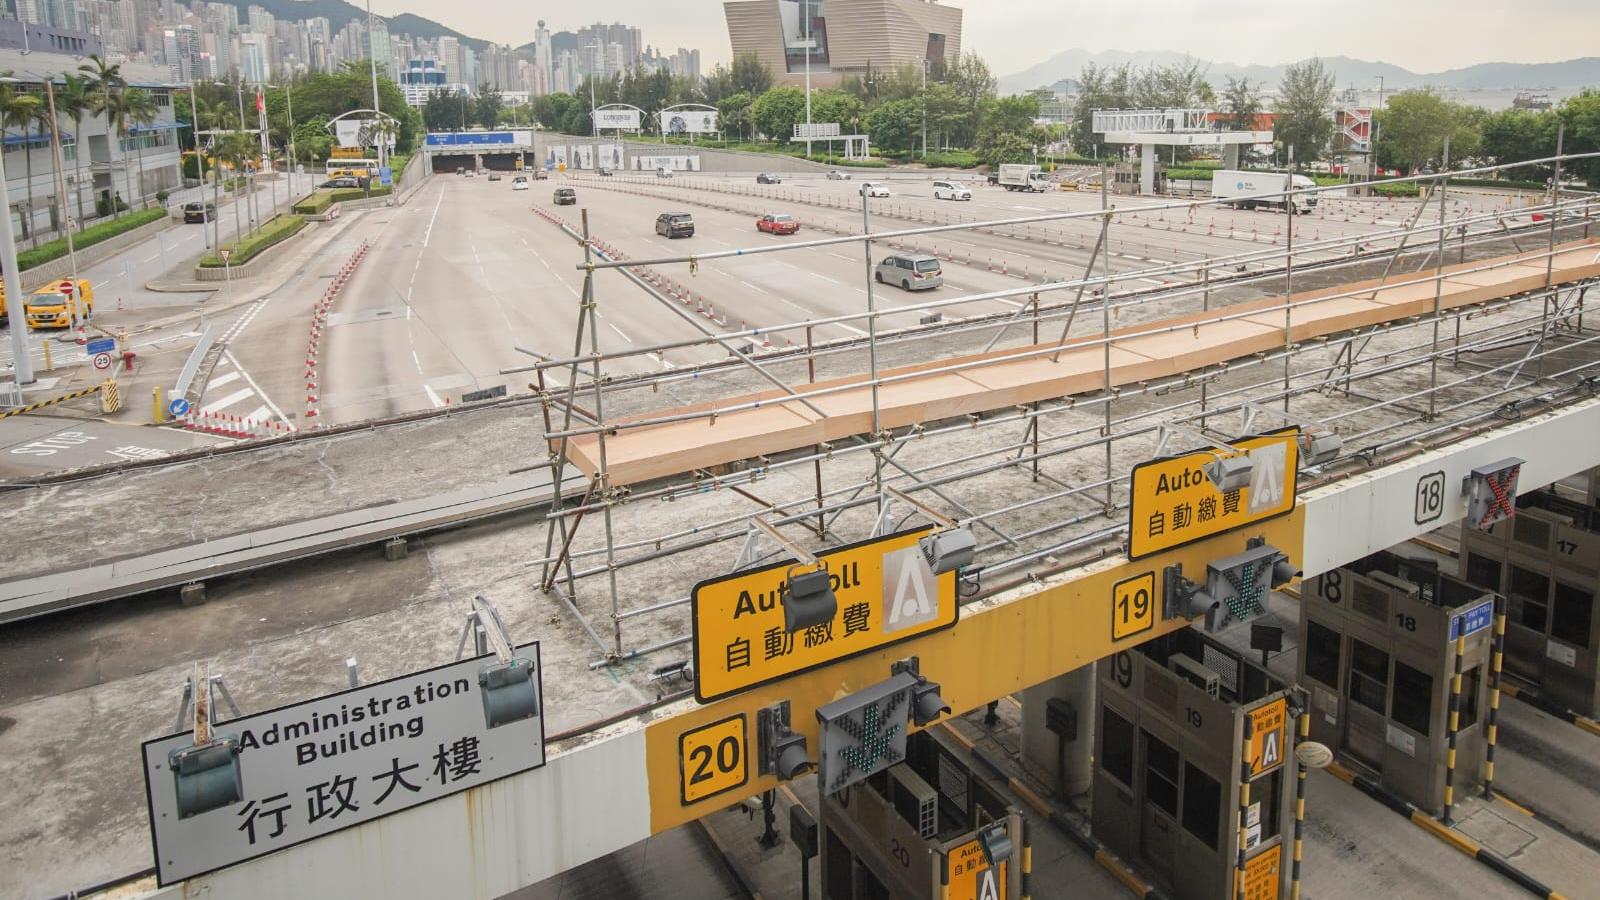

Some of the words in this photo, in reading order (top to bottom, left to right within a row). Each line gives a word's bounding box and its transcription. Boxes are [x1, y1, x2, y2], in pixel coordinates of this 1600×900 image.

[97, 357, 108, 366] 25
[10, 431, 97, 456] STOP
[1149, 490, 1240, 538] 自動繳費
[1420, 480, 1440, 514] 18
[1556, 540, 1578, 555] 17
[733, 561, 861, 619] Autoll
[1317, 568, 1342, 603] 18
[1118, 588, 1149, 624] 19
[1396, 613, 1417, 632] 18
[239, 678, 469, 752] Administration
[1185, 707, 1203, 728] 19
[297, 715, 425, 765] Building
[688, 736, 740, 786] 20
[237, 736, 481, 845] 行政大樓
[892, 838, 910, 868] 20
